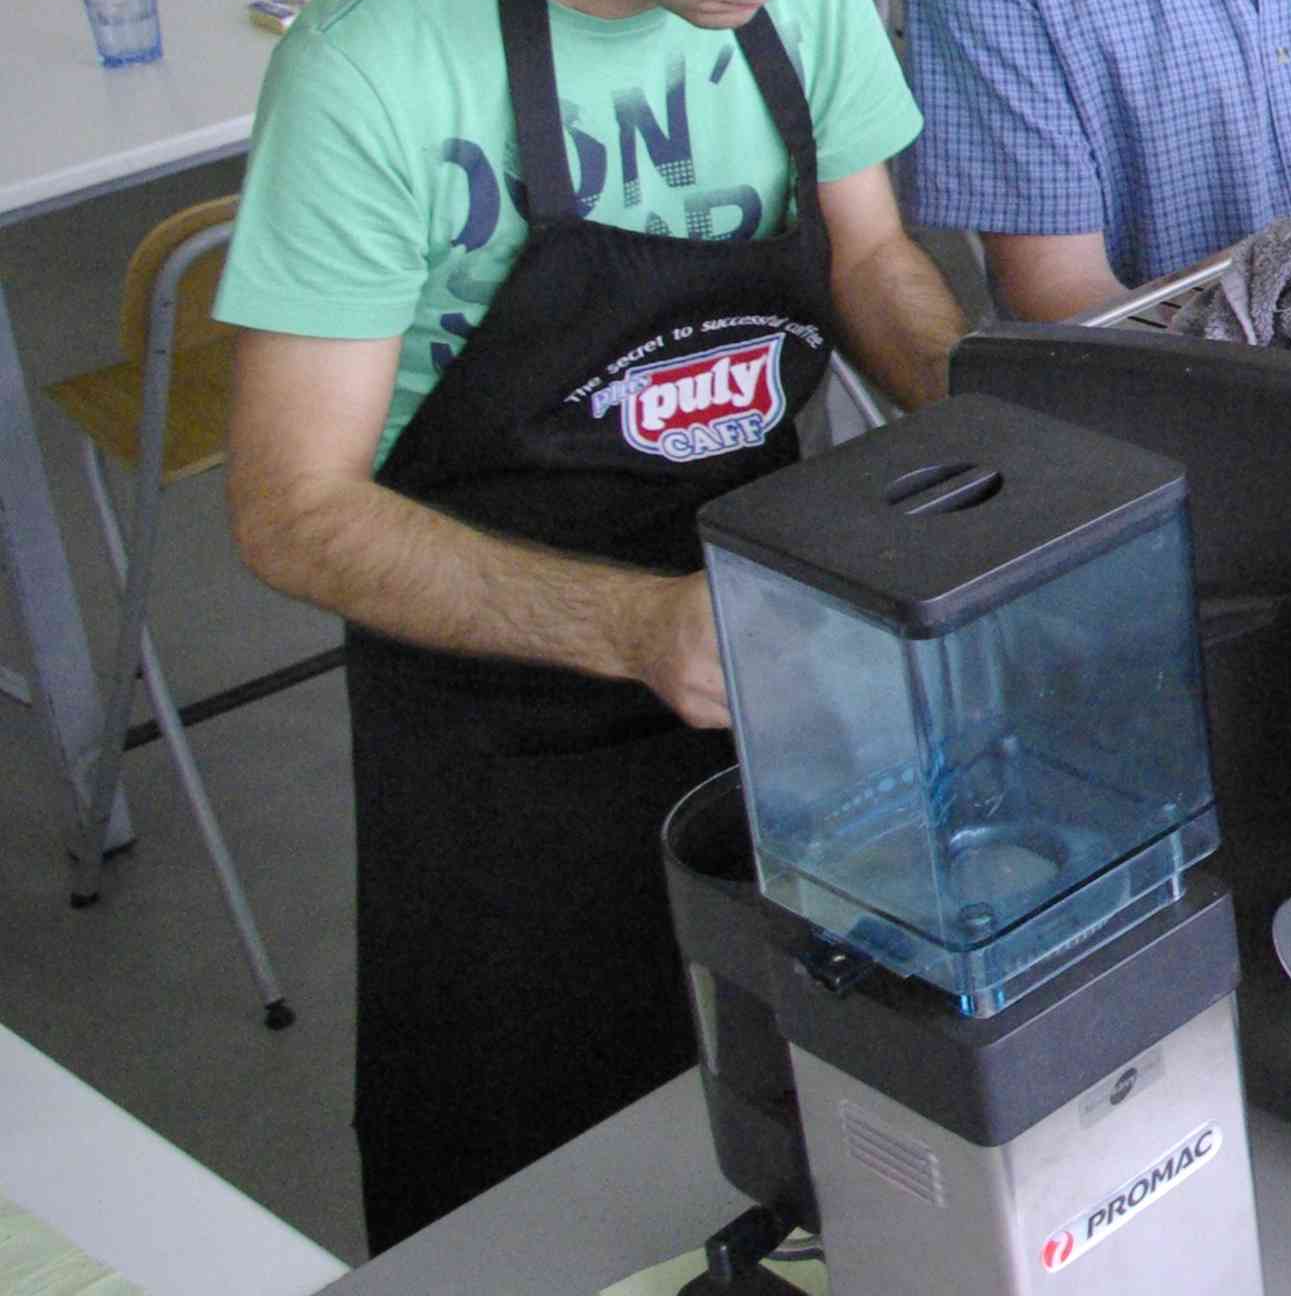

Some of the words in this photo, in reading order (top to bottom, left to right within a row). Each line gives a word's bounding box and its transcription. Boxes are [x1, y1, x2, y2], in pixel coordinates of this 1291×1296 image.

[564, 376, 601, 403] The
[607, 335, 664, 374] secret
[672, 326, 693, 341] to
[639, 356, 767, 431] puly
[661, 412, 766, 460] CAFF
[1086, 1129, 1213, 1240] PROMAC
